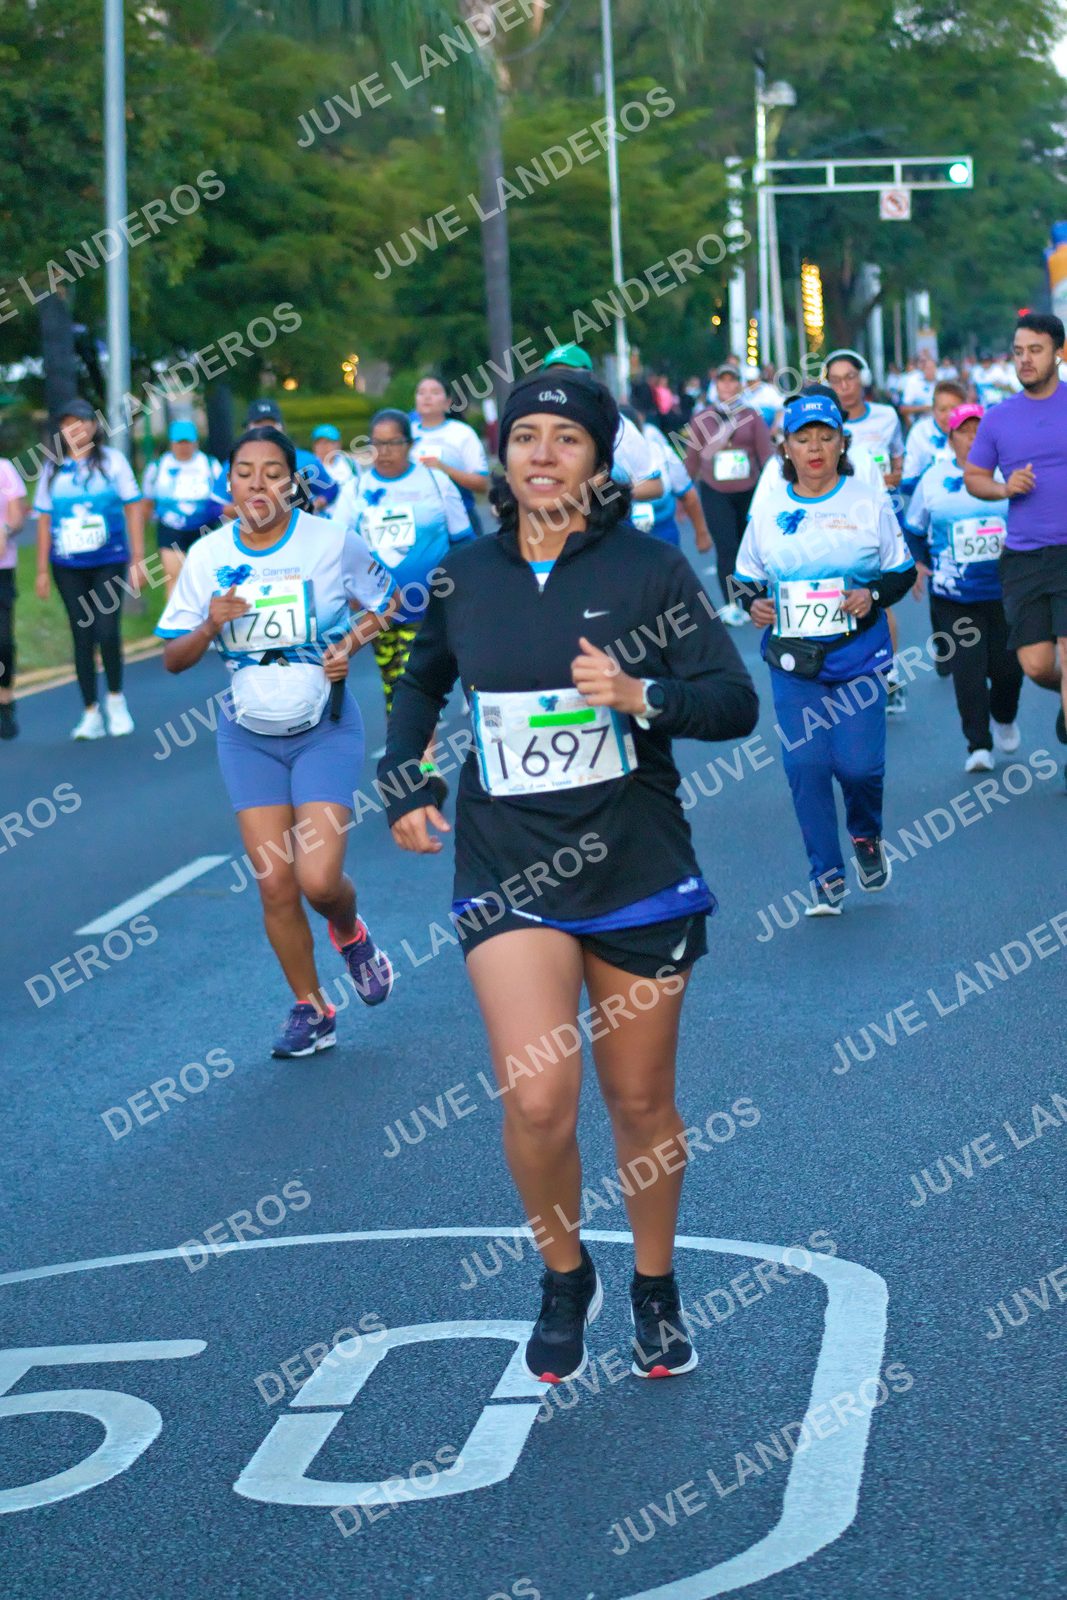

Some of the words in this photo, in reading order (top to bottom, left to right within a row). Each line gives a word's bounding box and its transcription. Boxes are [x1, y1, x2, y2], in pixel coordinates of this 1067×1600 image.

[363, 522, 413, 547] 1797
[963, 536, 1001, 556] 523
[230, 608, 297, 643] 1761
[783, 603, 846, 629] 1794
[492, 724, 611, 780] 1697
